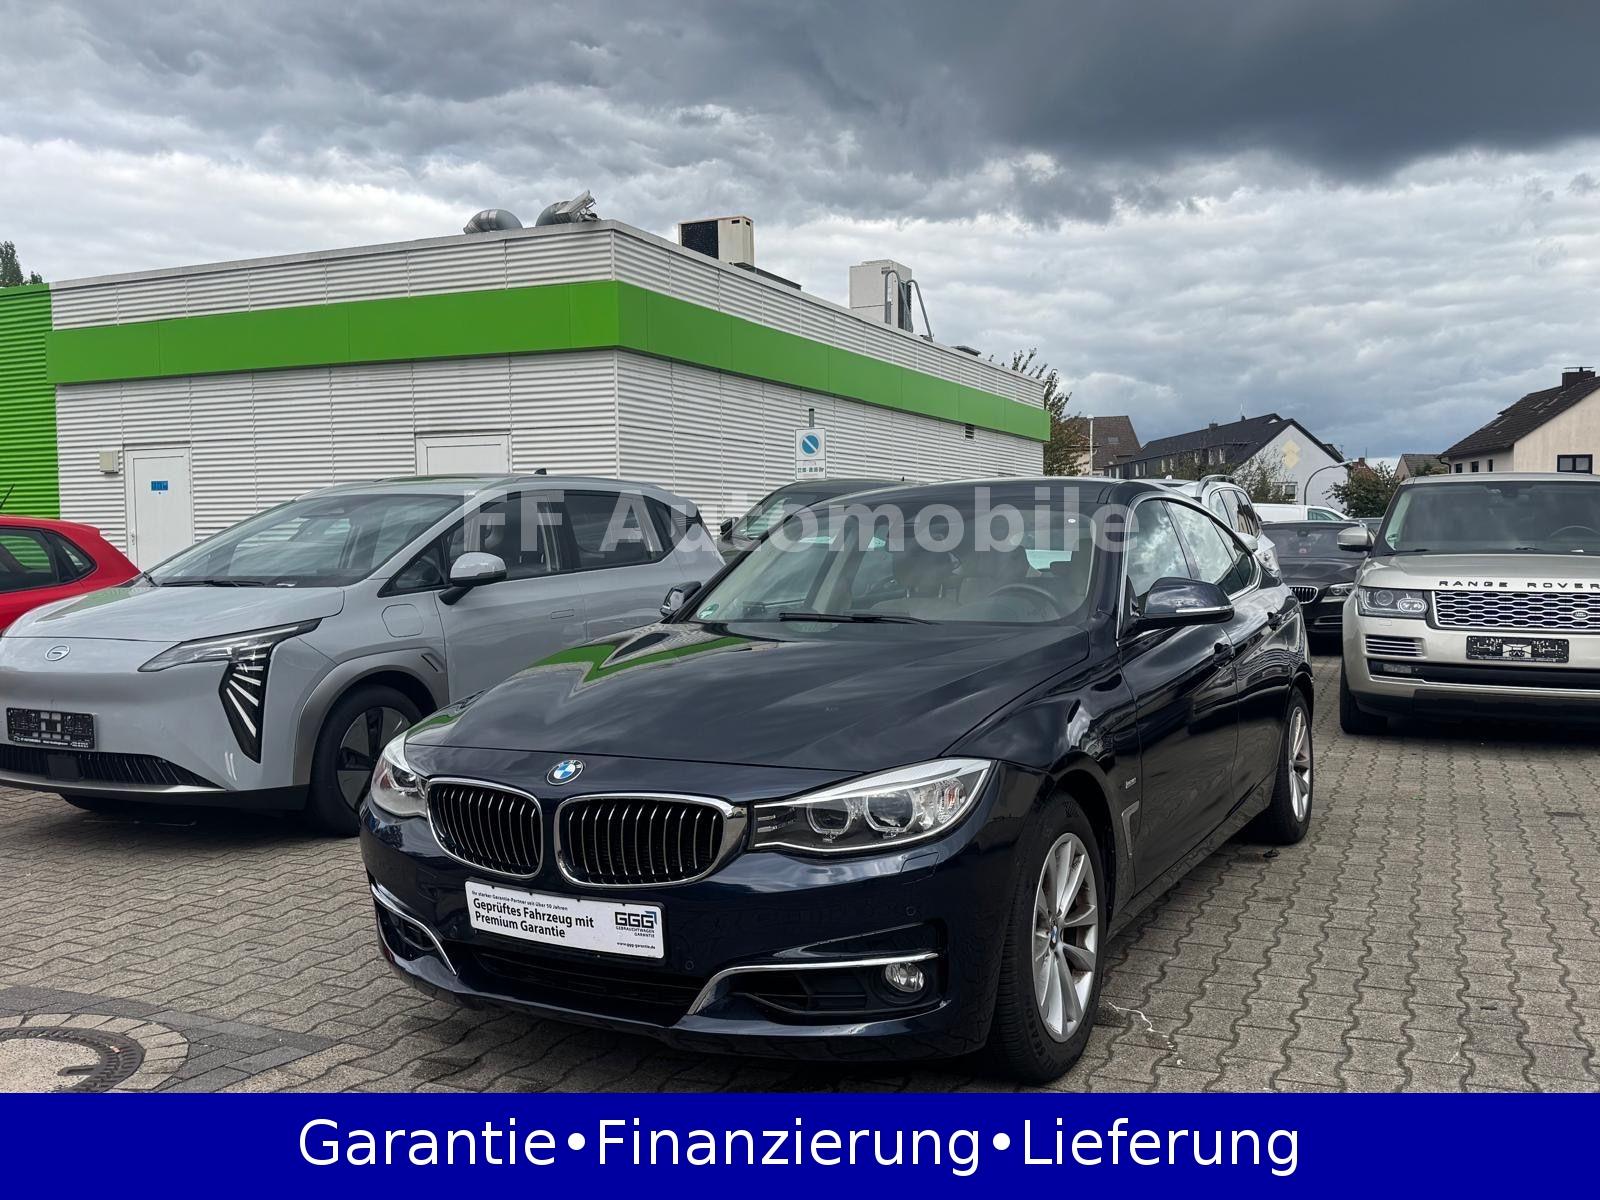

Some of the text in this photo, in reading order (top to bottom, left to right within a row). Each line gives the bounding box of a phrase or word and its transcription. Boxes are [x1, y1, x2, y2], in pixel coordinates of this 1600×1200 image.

[1439, 580, 1508, 588] RANGE
[473, 898, 594, 928] Geprüftes Fahrzeug mit
[615, 911, 655, 929] GGG
[475, 911, 566, 938] Premium Garantie
